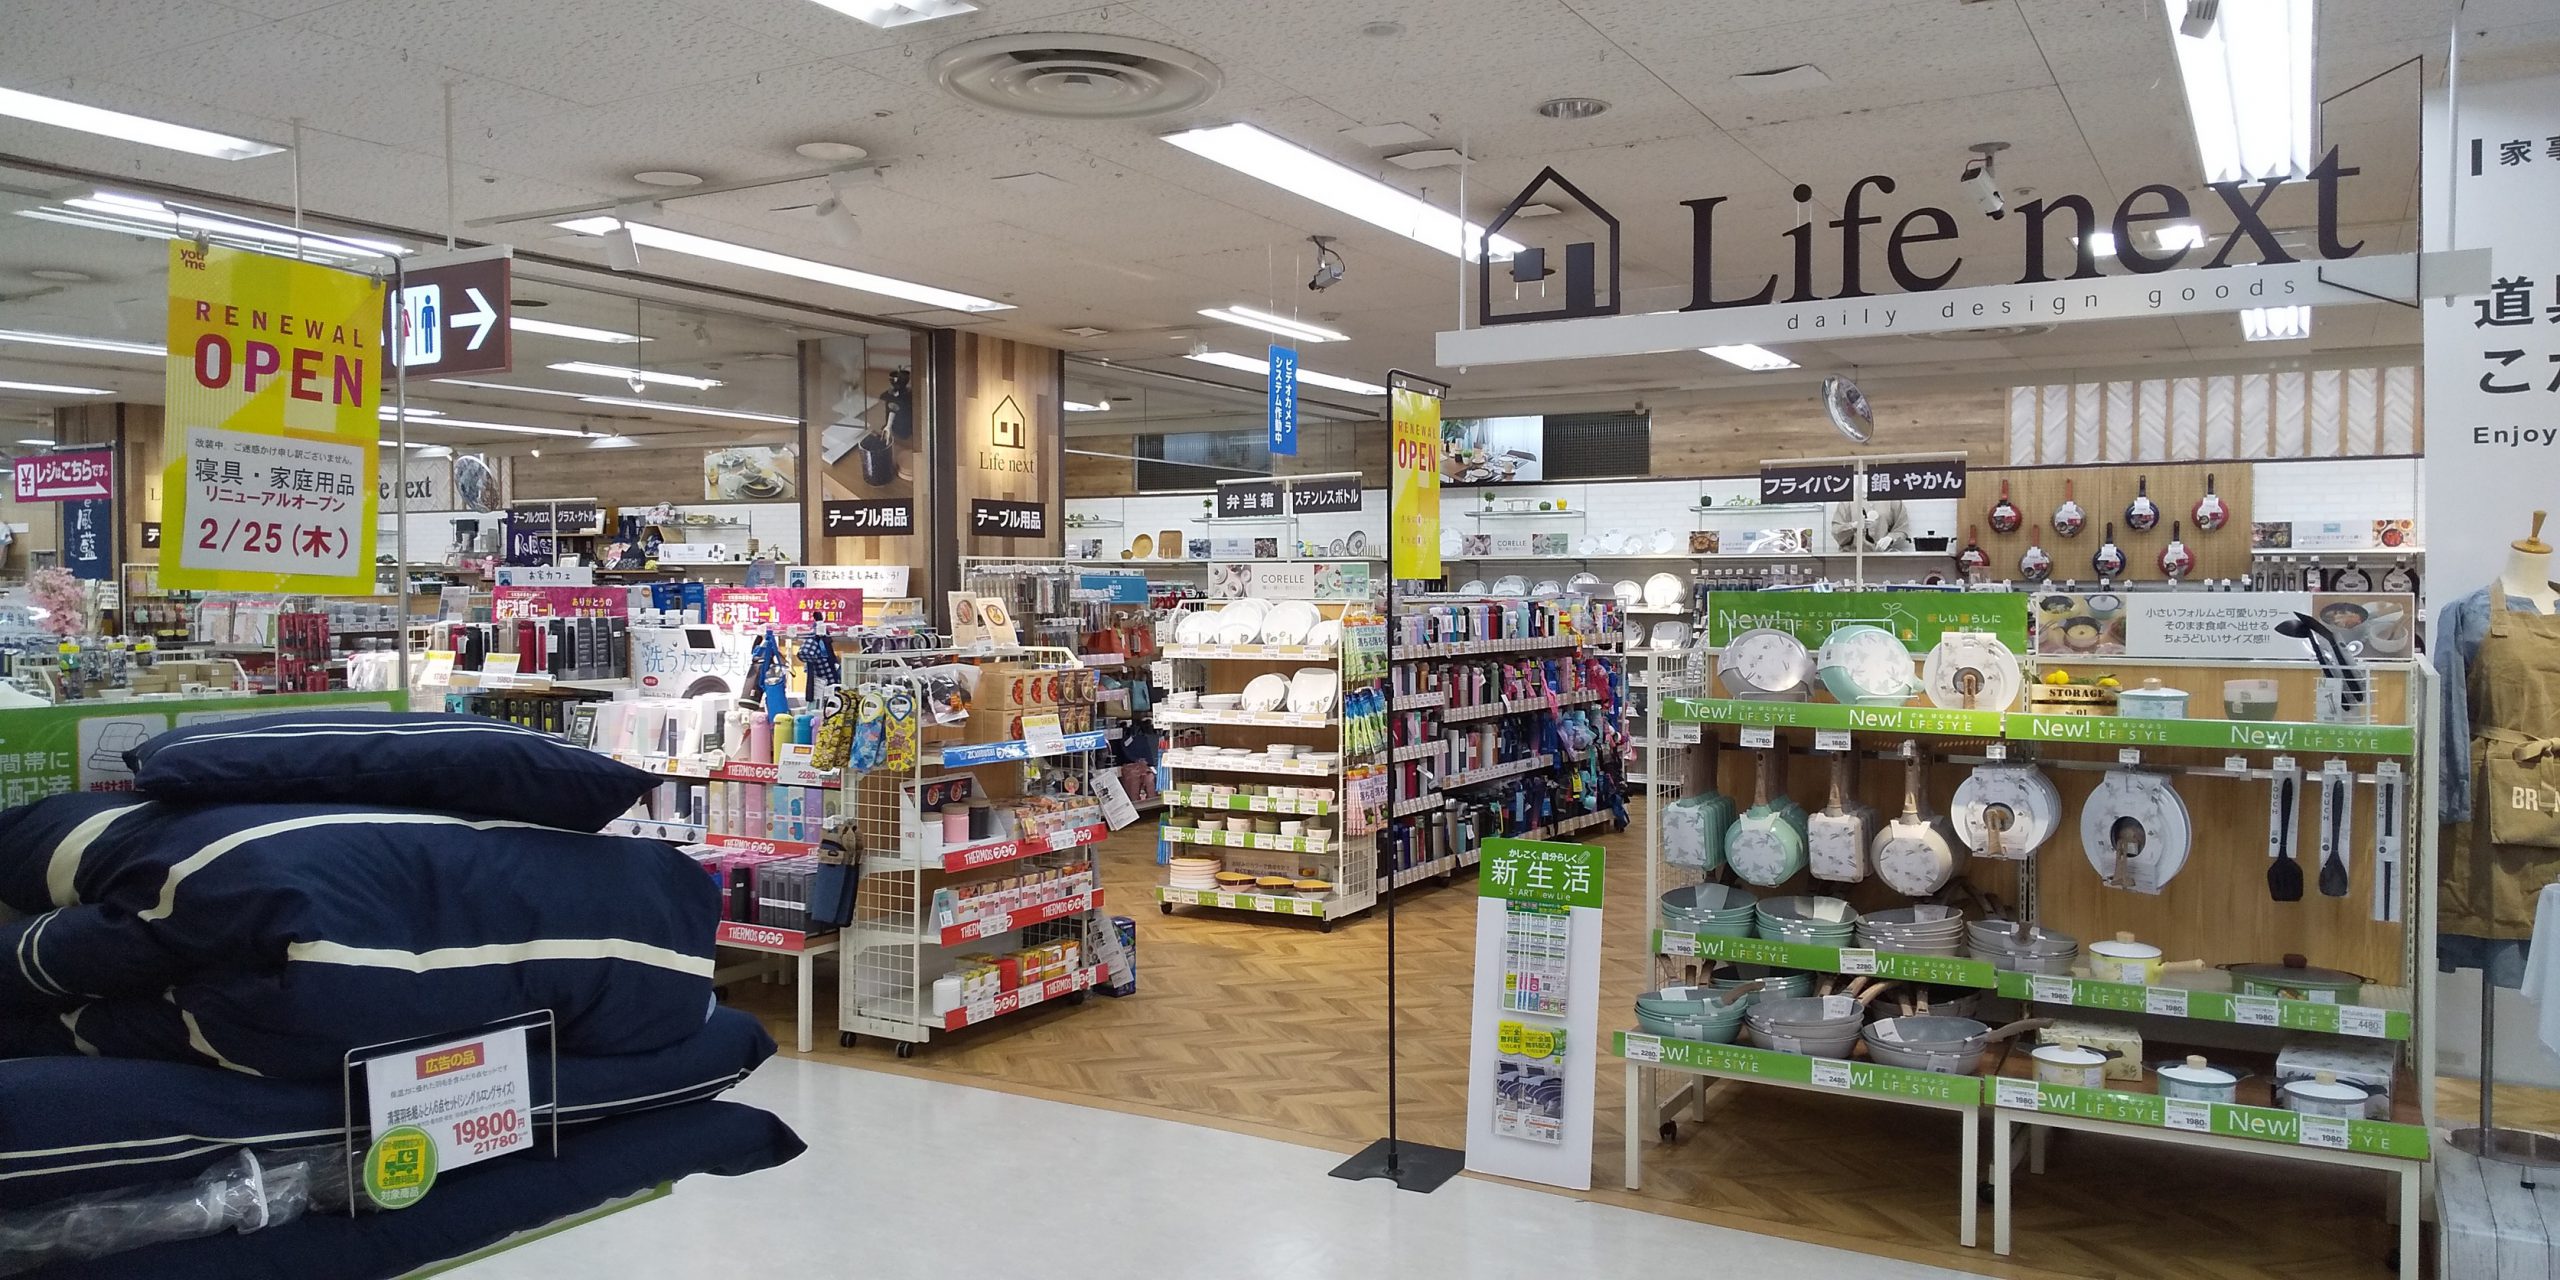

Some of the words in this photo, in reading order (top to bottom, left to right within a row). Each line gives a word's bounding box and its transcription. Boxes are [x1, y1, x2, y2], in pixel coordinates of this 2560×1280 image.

[1678, 176, 1962, 312] Life
[2014, 143, 2365, 286] next
[1787, 304, 1898, 333] daily
[1941, 290, 2099, 318] design
[2147, 277, 2297, 308] goods
[2474, 274, 2560, 329] 道
[195, 300, 364, 349] RENEWAL
[194, 333, 363, 408] OPEN
[2479, 348, 2560, 394] こ
[1397, 420, 1437, 439] RENEWAL
[2473, 425, 2558, 448] Enjoy
[979, 451, 1005, 471] Life
[1008, 455, 1035, 474] next
[1398, 438, 1437, 473] OPEN
[195, 458, 355, 496] 寝具・家庭用品
[1764, 476, 1850, 496] フライパン
[1871, 470, 1963, 493] 鍋・やかん
[206, 486, 345, 513] リニューアルオープン
[1226, 492, 1274, 510] 弁当箱
[1295, 489, 1359, 507] ステンレスボトル
[828, 507, 908, 529] テーブル用品
[977, 508, 1041, 531] テーブル用品
[199, 518, 349, 560] 2/25(木)
[1261, 574, 1305, 584] CORELLE
[1719, 609, 1780, 630] New!
[2146, 608, 2290, 619] 小さいフォルムと可愛いカラー
[2164, 620, 2270, 631] そのまま食卓へ出せる
[2049, 688, 2106, 699] STORAGE
[1684, 703, 1733, 720] New!
[1850, 709, 1902, 728] New!
[2033, 718, 2091, 738] New!
[2231, 724, 2295, 746] New!
[728, 764, 755, 778] THERMOS
[964, 850, 994, 866] THERMOS
[1508, 847, 1578, 864] かしこく、自分らしく
[1491, 857, 1592, 895] 新生活
[1042, 901, 1068, 918] THERMOS
[728, 926, 758, 942] THERMOS
[1694, 940, 1724, 957] ew!
[1046, 977, 1072, 997] THERMOS
[425, 1049, 477, 1075] 広告の品
[1660, 1044, 1690, 1063] ew!
[2037, 1091, 2076, 1111] ew!
[2229, 1109, 2298, 1138] New!
